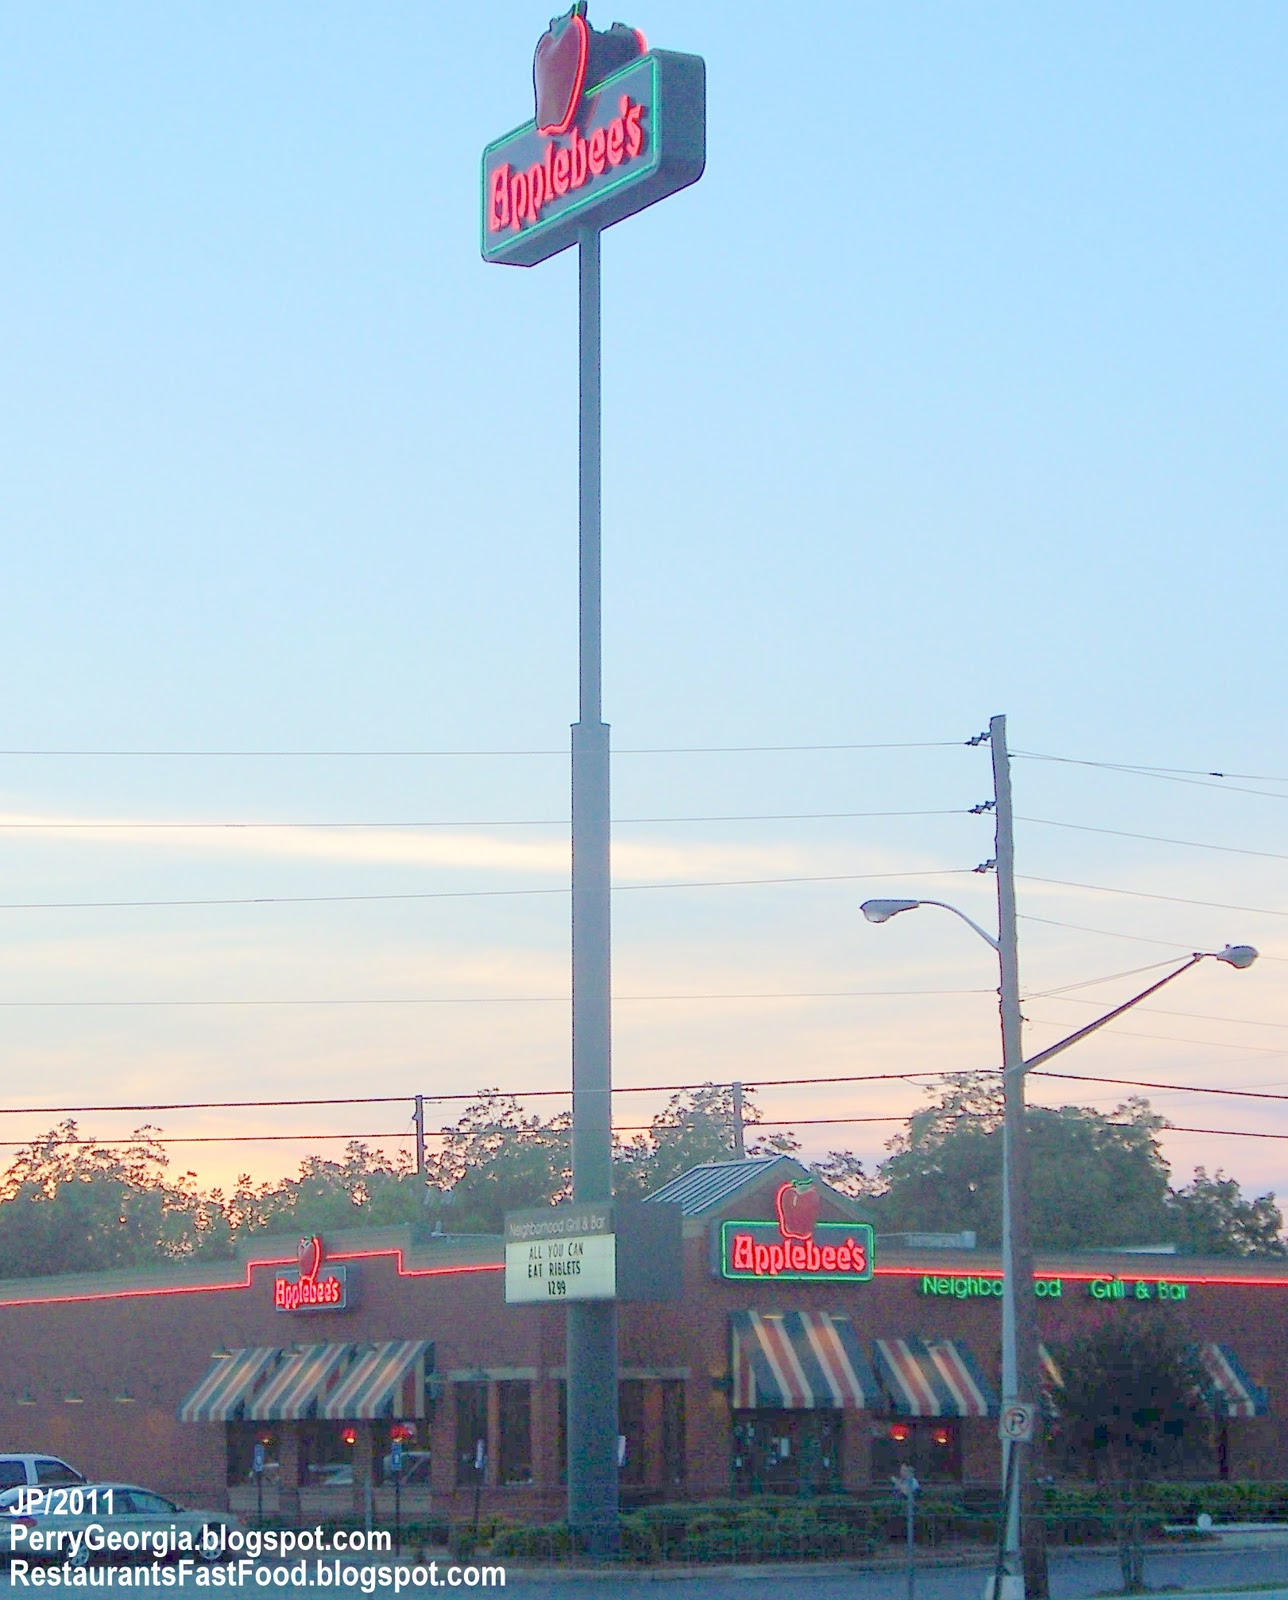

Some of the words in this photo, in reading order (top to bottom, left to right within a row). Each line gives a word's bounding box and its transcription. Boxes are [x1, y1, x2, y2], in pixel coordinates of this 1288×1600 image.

[489, 94, 644, 232] Applebee's
[529, 1246, 542, 1260] ALL
[548, 1243, 564, 1259] YOU
[568, 1242, 584, 1256] CAN
[733, 1234, 866, 1276] Applebee's
[528, 1263, 542, 1278] EAT
[549, 1260, 581, 1276] RIBLETS
[275, 1276, 340, 1310] Applebee's
[1135, 1280, 1150, 1299] &
[1158, 1281, 1188, 1300] Bar
